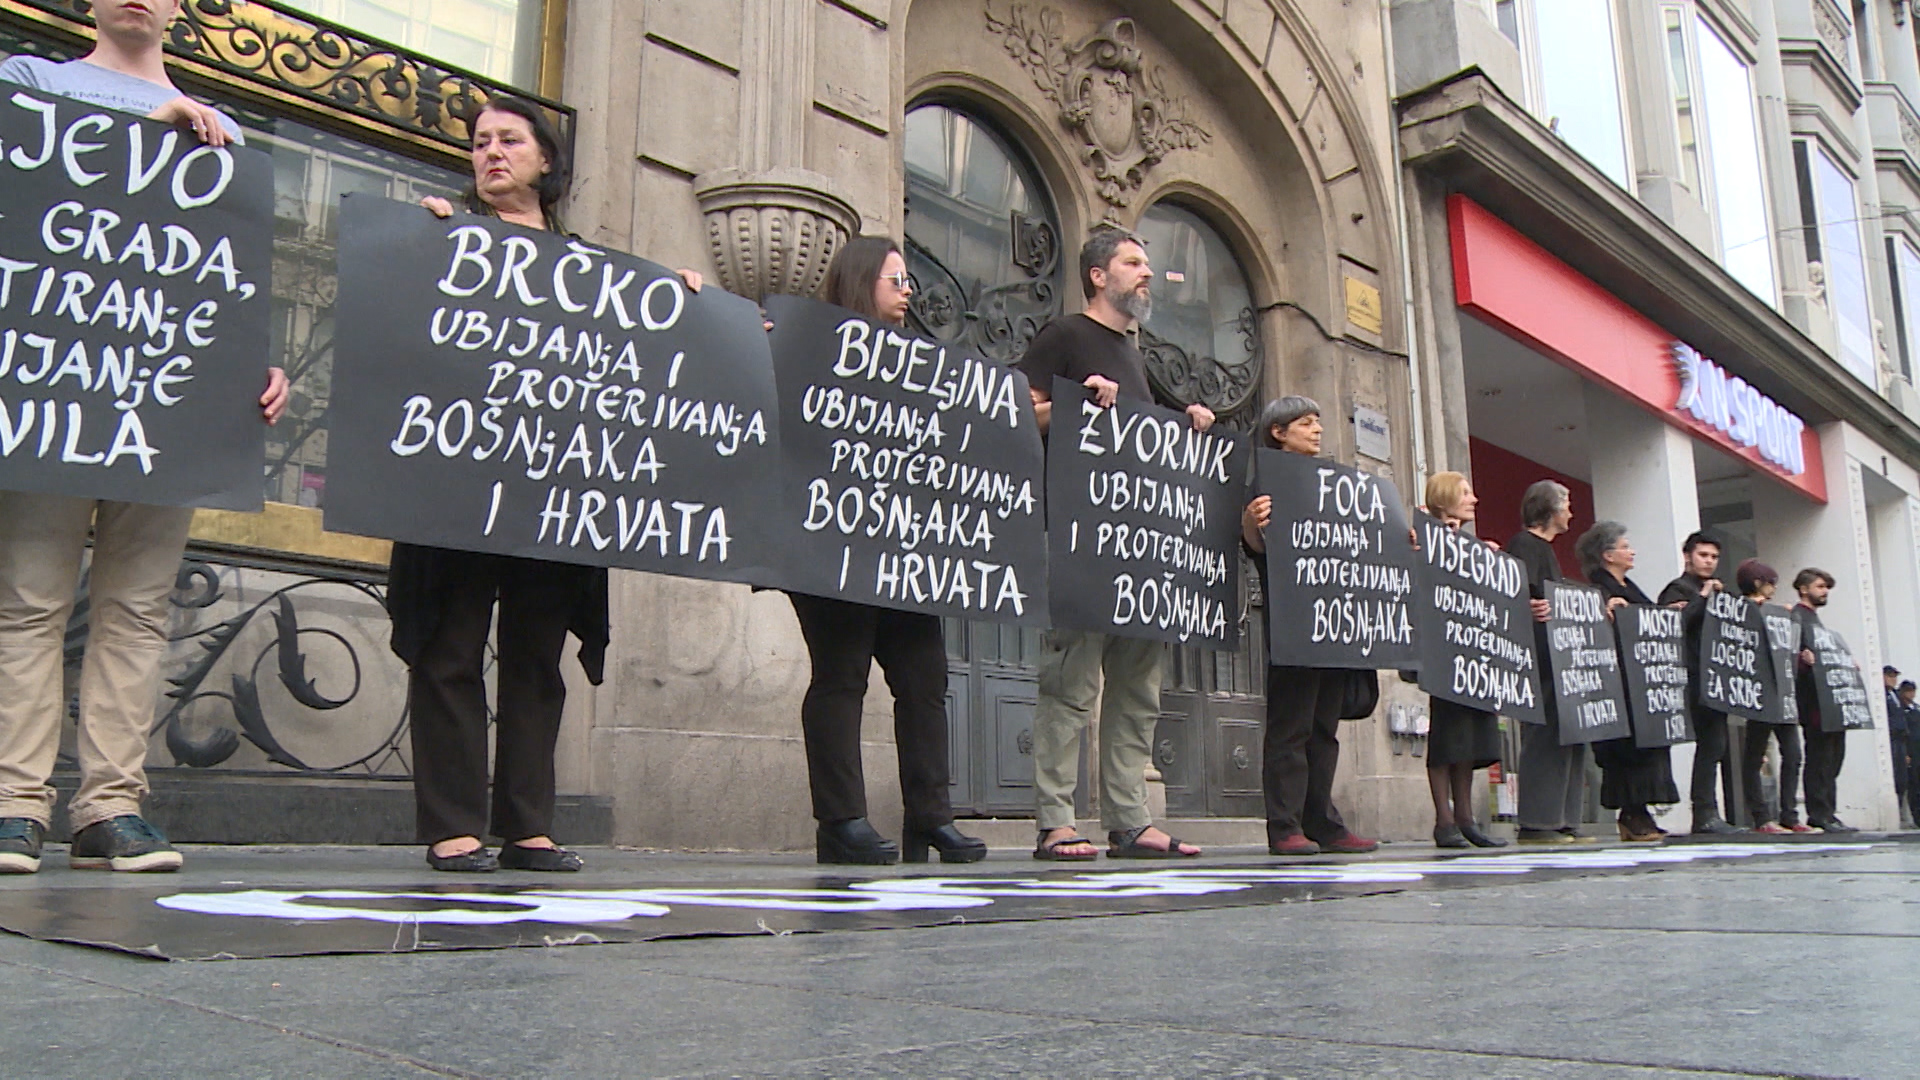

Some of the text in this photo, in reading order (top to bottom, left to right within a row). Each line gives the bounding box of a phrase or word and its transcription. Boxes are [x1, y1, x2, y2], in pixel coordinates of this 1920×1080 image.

[0, 92, 234, 210] JEVO
[41, 200, 257, 300] GRADA,
[437, 225, 685, 331] BRČKO
[668, 350, 685, 388] I
[960, 422, 972, 453] I
[1079, 399, 1235, 484] ZVORNIK
[484, 480, 733, 563] I HRVATA
[1317, 467, 1387, 524] FOČA
[1070, 520, 1079, 553] I
[1377, 529, 1382, 554] I
[1425, 521, 1521, 598] VIŠEGRAD
[839, 545, 1029, 616] I HRVATA
[1503, 609, 1509, 631] I
[1711, 640, 1756, 675] LOGOR
[1728, 675, 1764, 710] SRBE
